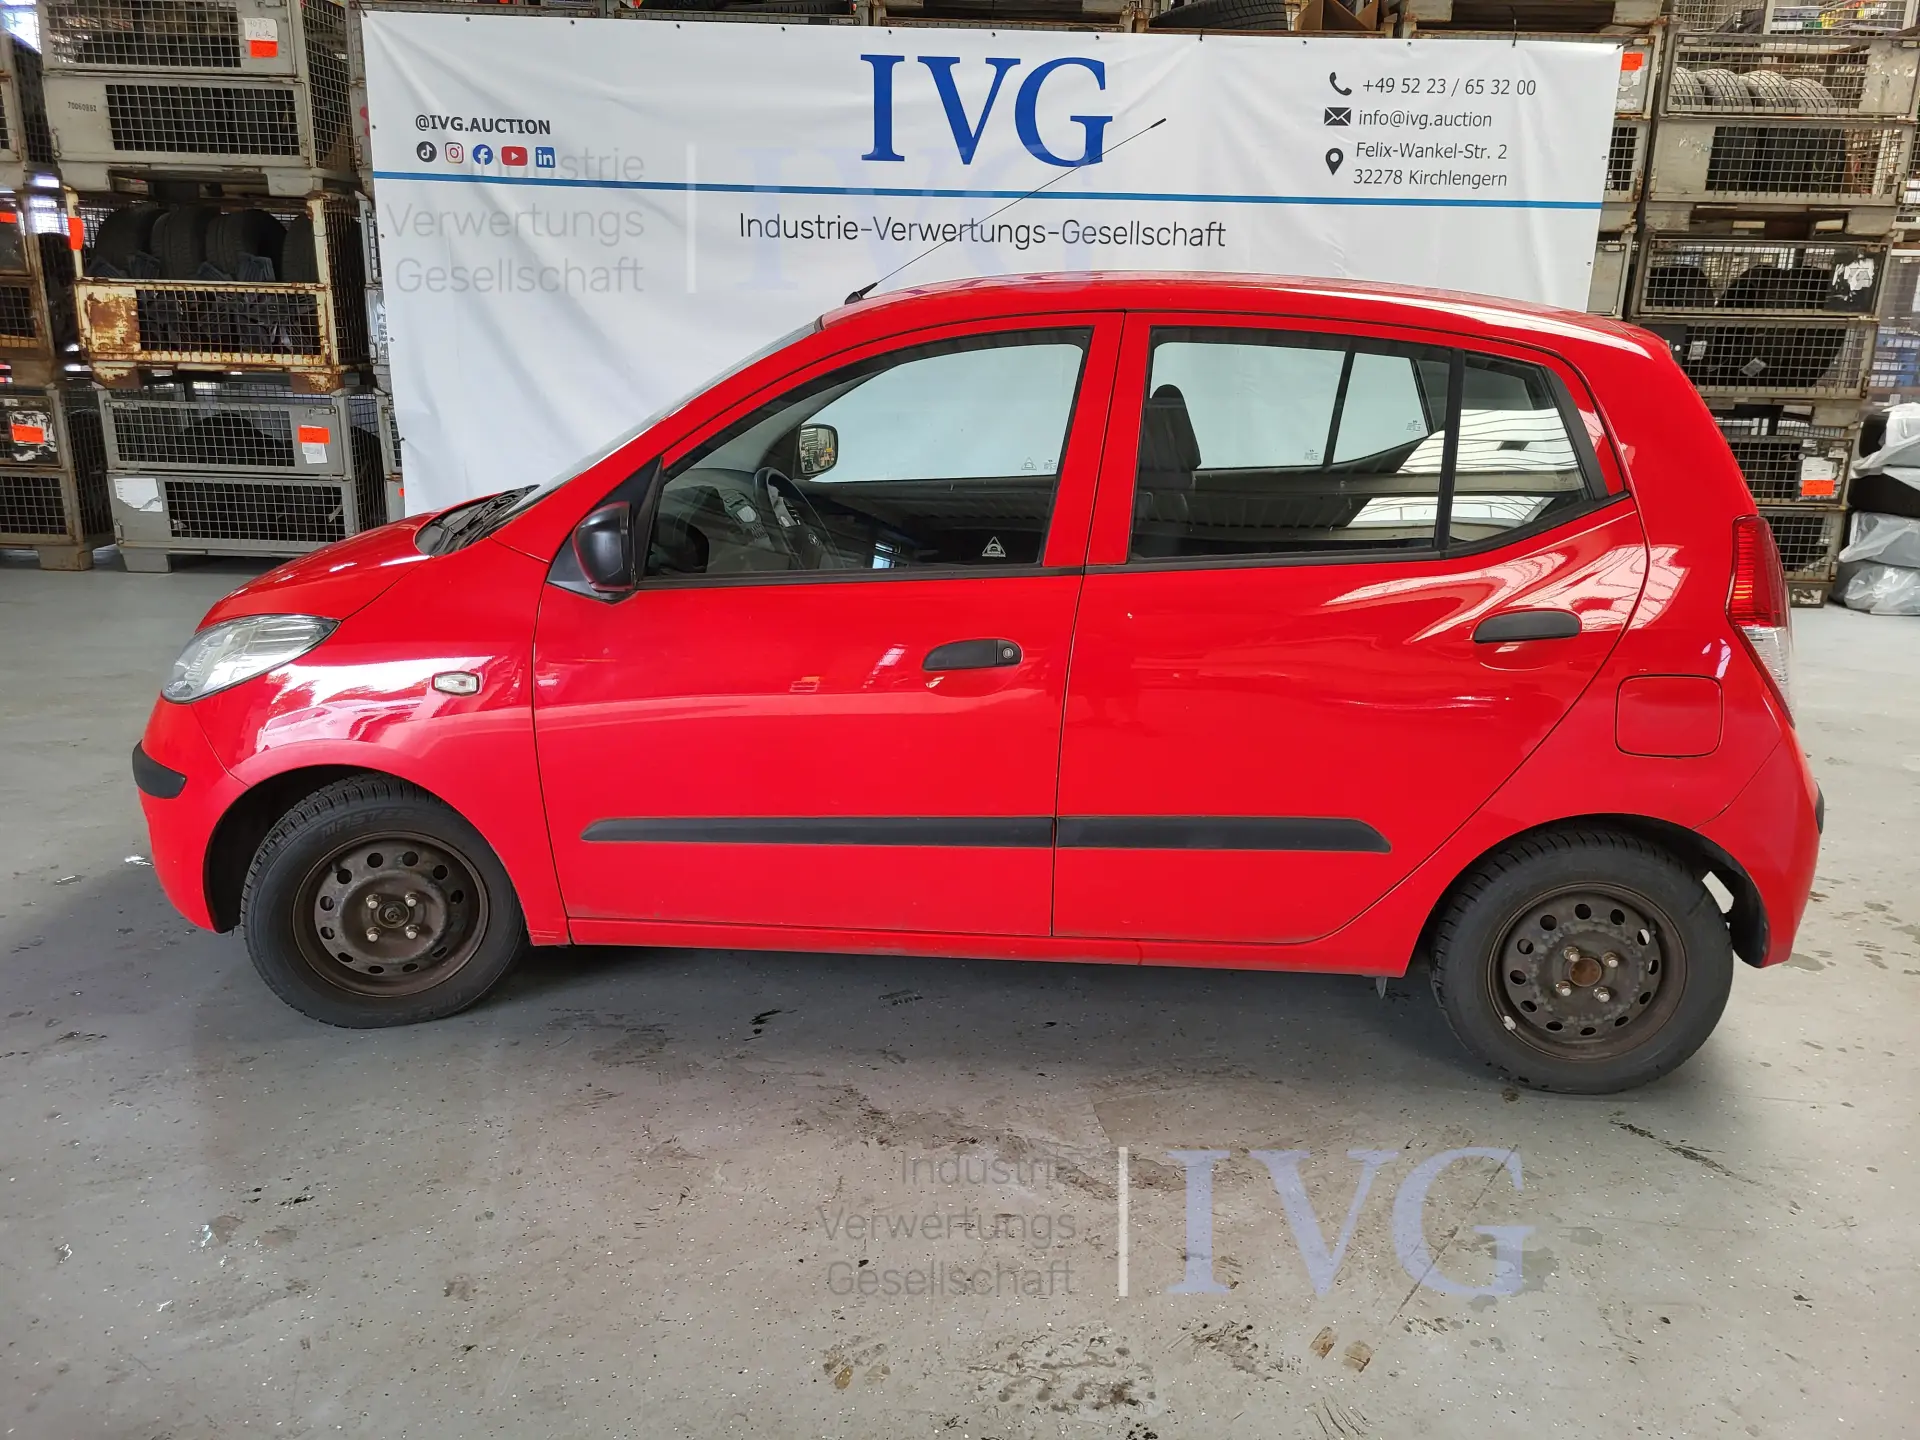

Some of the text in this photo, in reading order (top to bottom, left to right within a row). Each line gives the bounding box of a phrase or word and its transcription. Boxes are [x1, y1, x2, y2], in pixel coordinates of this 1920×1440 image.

[1362, 78, 1536, 97] +49 52 23 / 65 32 00
[860, 54, 1113, 168] IVG
[1358, 110, 1492, 130] info@ivg.auction
[415, 114, 551, 135] @IVG.AUCTION
[1356, 142, 1507, 160] Felix-Wankel-Str. 2
[1353, 169, 1507, 189] 32278 Kirchlengern
[739, 212, 1227, 250] Industrie-Verwertungs-Gesellschaft
